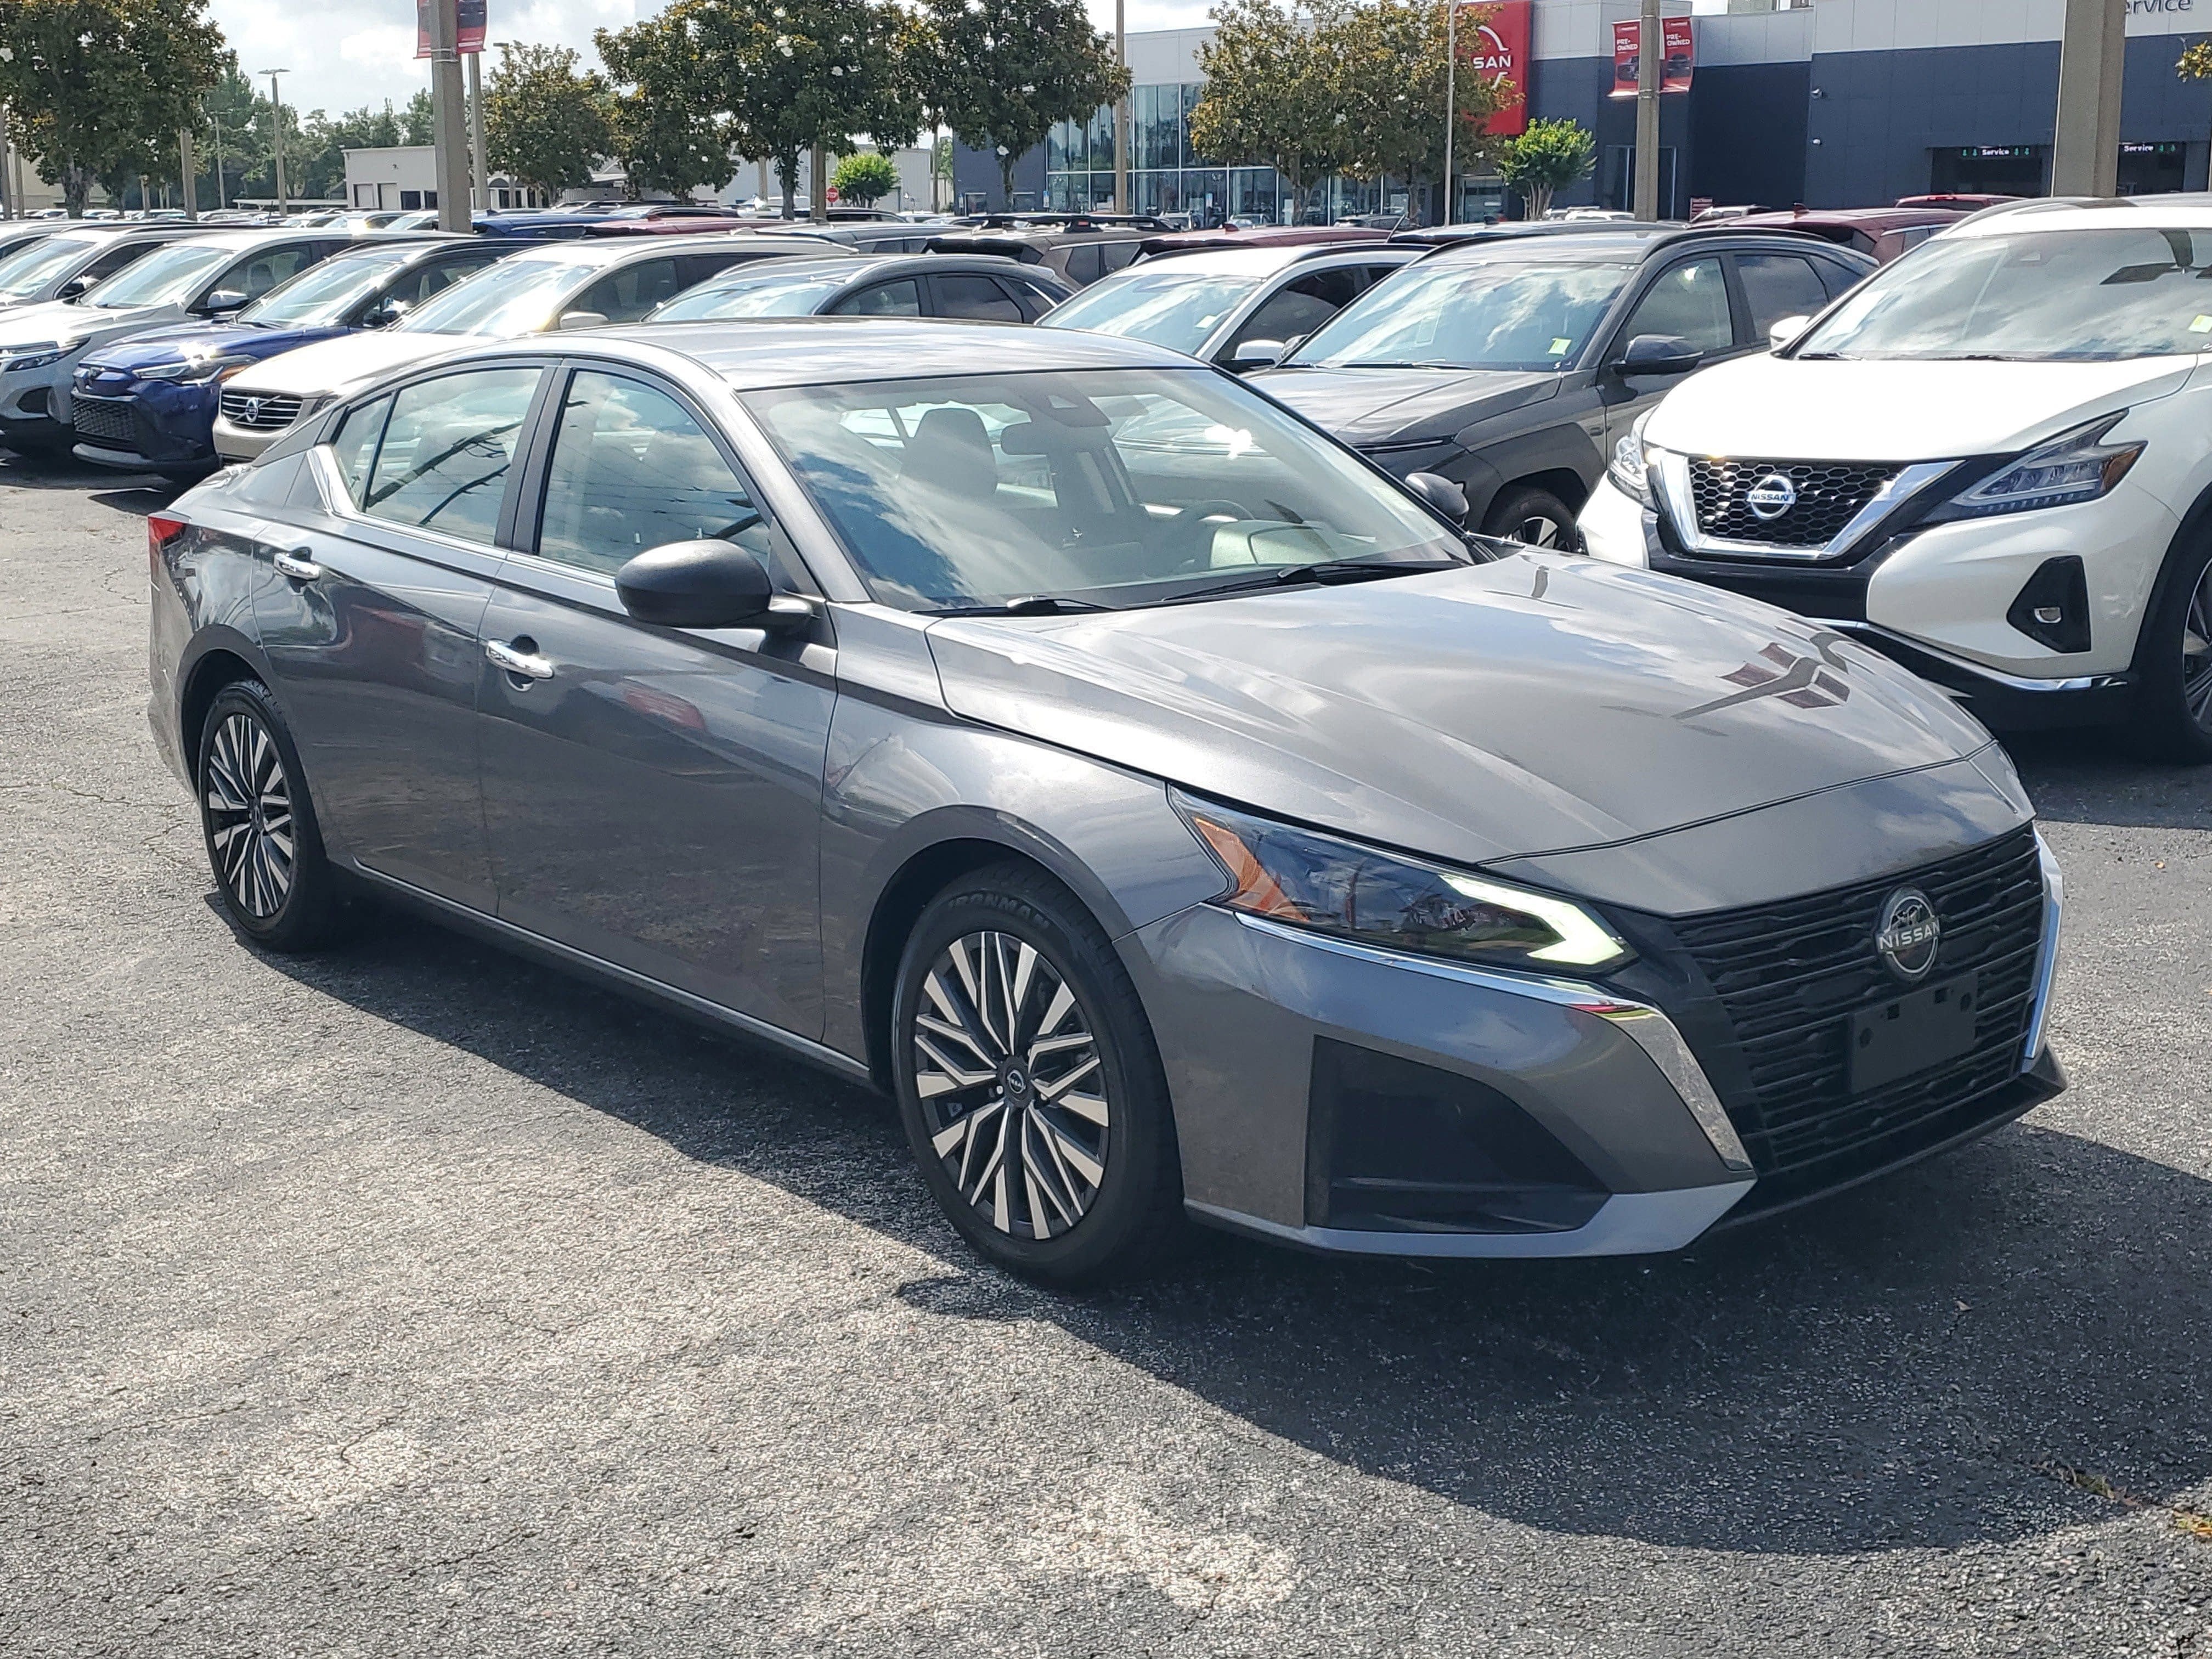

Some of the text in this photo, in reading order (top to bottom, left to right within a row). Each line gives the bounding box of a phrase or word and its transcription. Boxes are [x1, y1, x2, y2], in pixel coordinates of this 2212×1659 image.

[2125, 0, 2191, 14] rvice
[1472, 54, 1511, 70] SAN
[2124, 144, 2154, 152] Service
[1751, 492, 1789, 501] NISSAN
[1879, 921, 1940, 950] NISSAN
